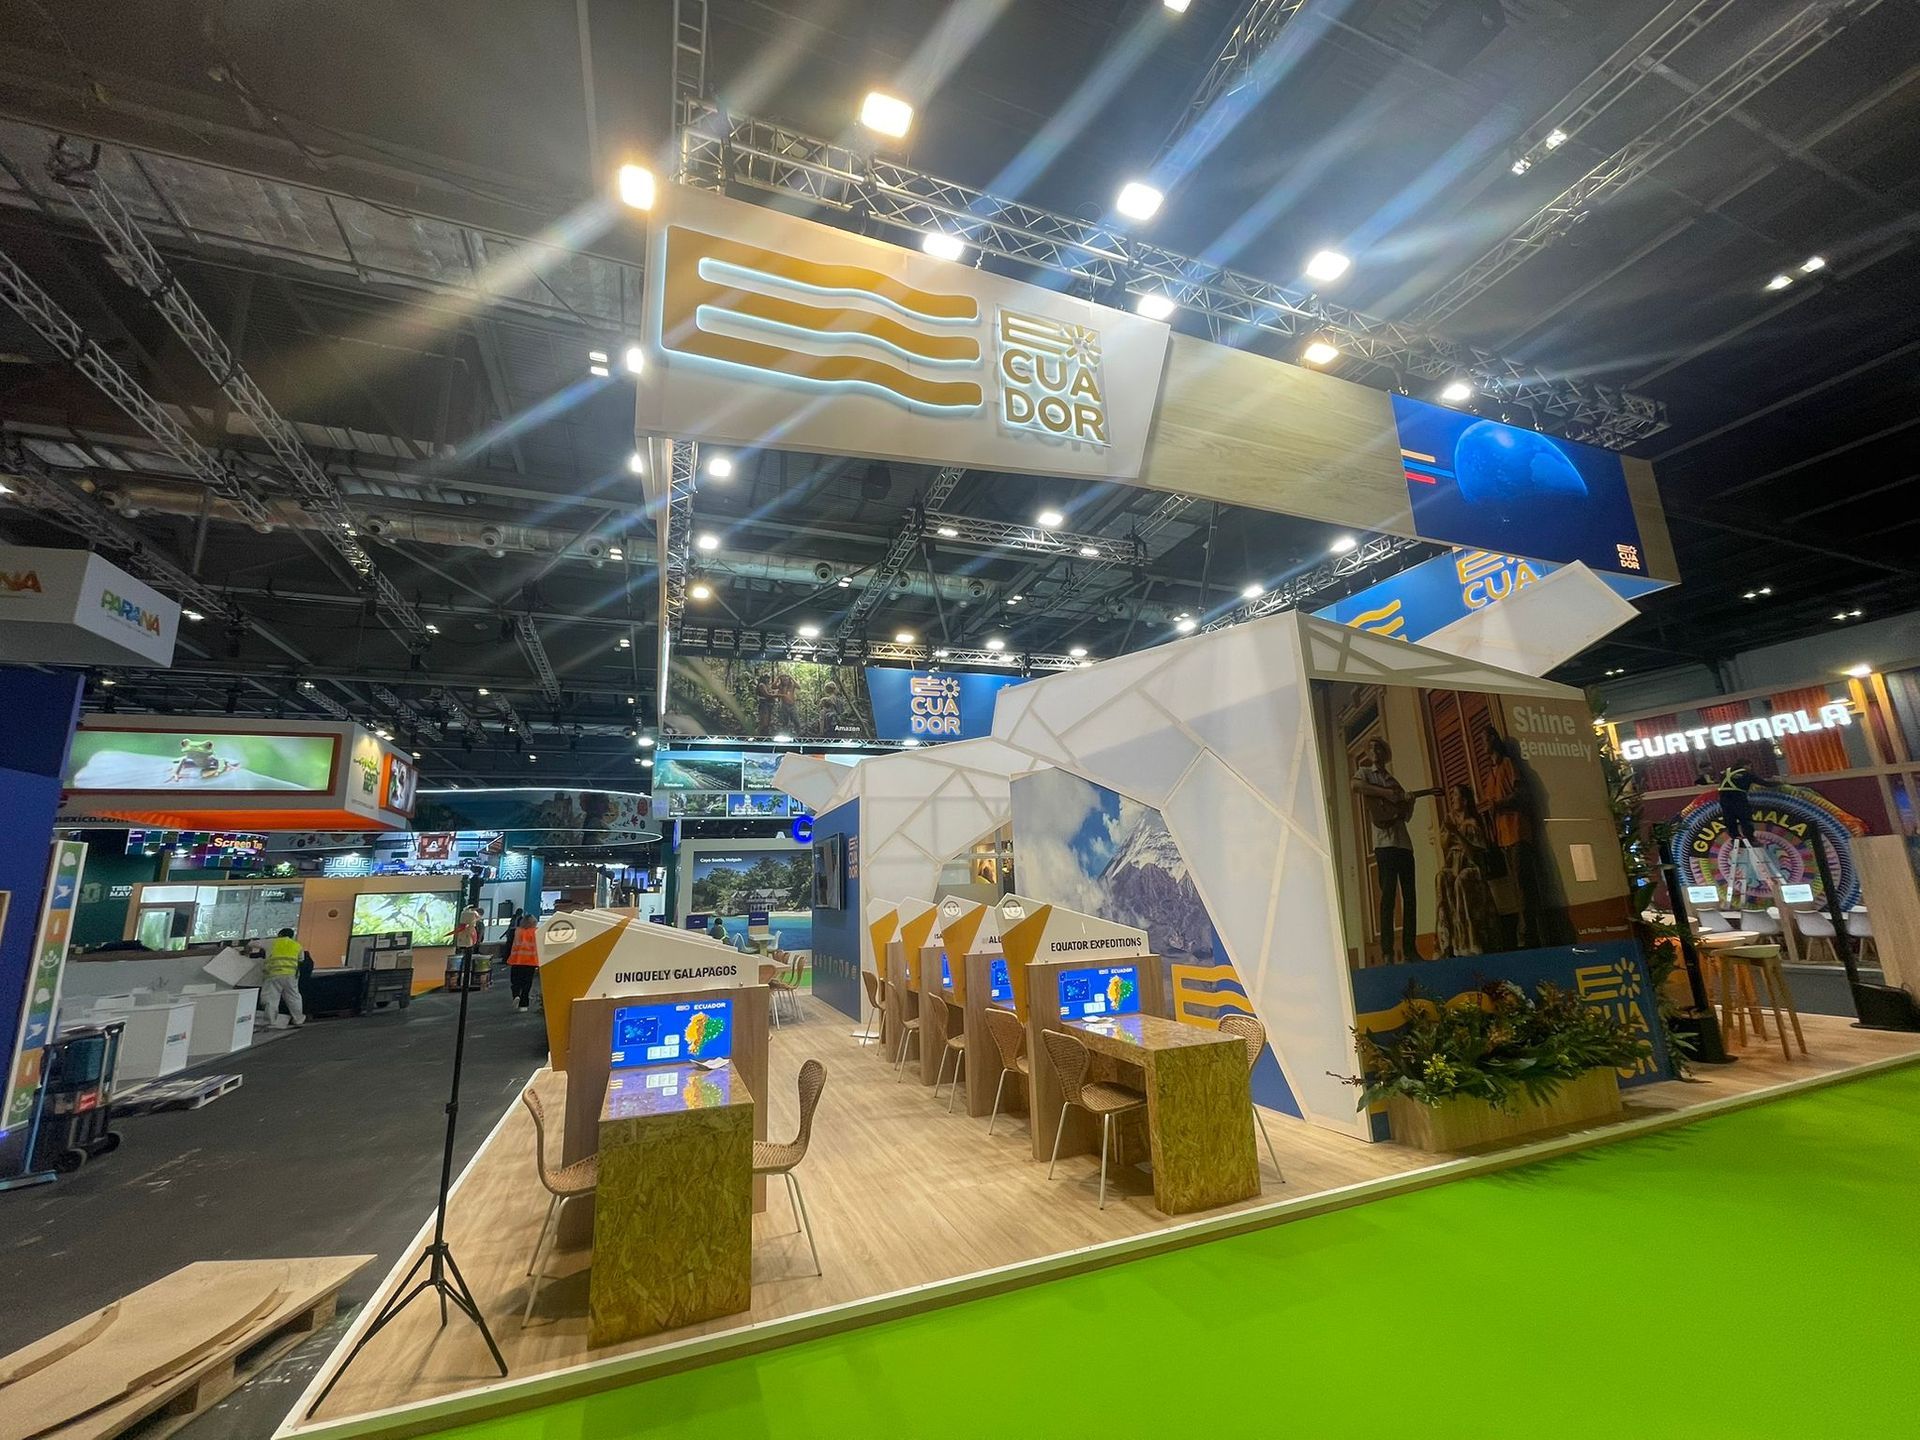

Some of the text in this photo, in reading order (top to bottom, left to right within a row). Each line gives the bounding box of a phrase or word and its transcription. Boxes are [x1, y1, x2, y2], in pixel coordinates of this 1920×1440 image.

[1513, 706, 1576, 735] Shine
[1621, 704, 1852, 760] GUATEMALA
[1520, 739, 1592, 762] genuinely
[214, 838, 251, 849] Screen
[1051, 937, 1142, 952] EQUATOR EXPEDITIONS
[615, 965, 737, 983] UNIQUELY GALAPAGOS
[694, 1002, 726, 1010] ECUADOR
